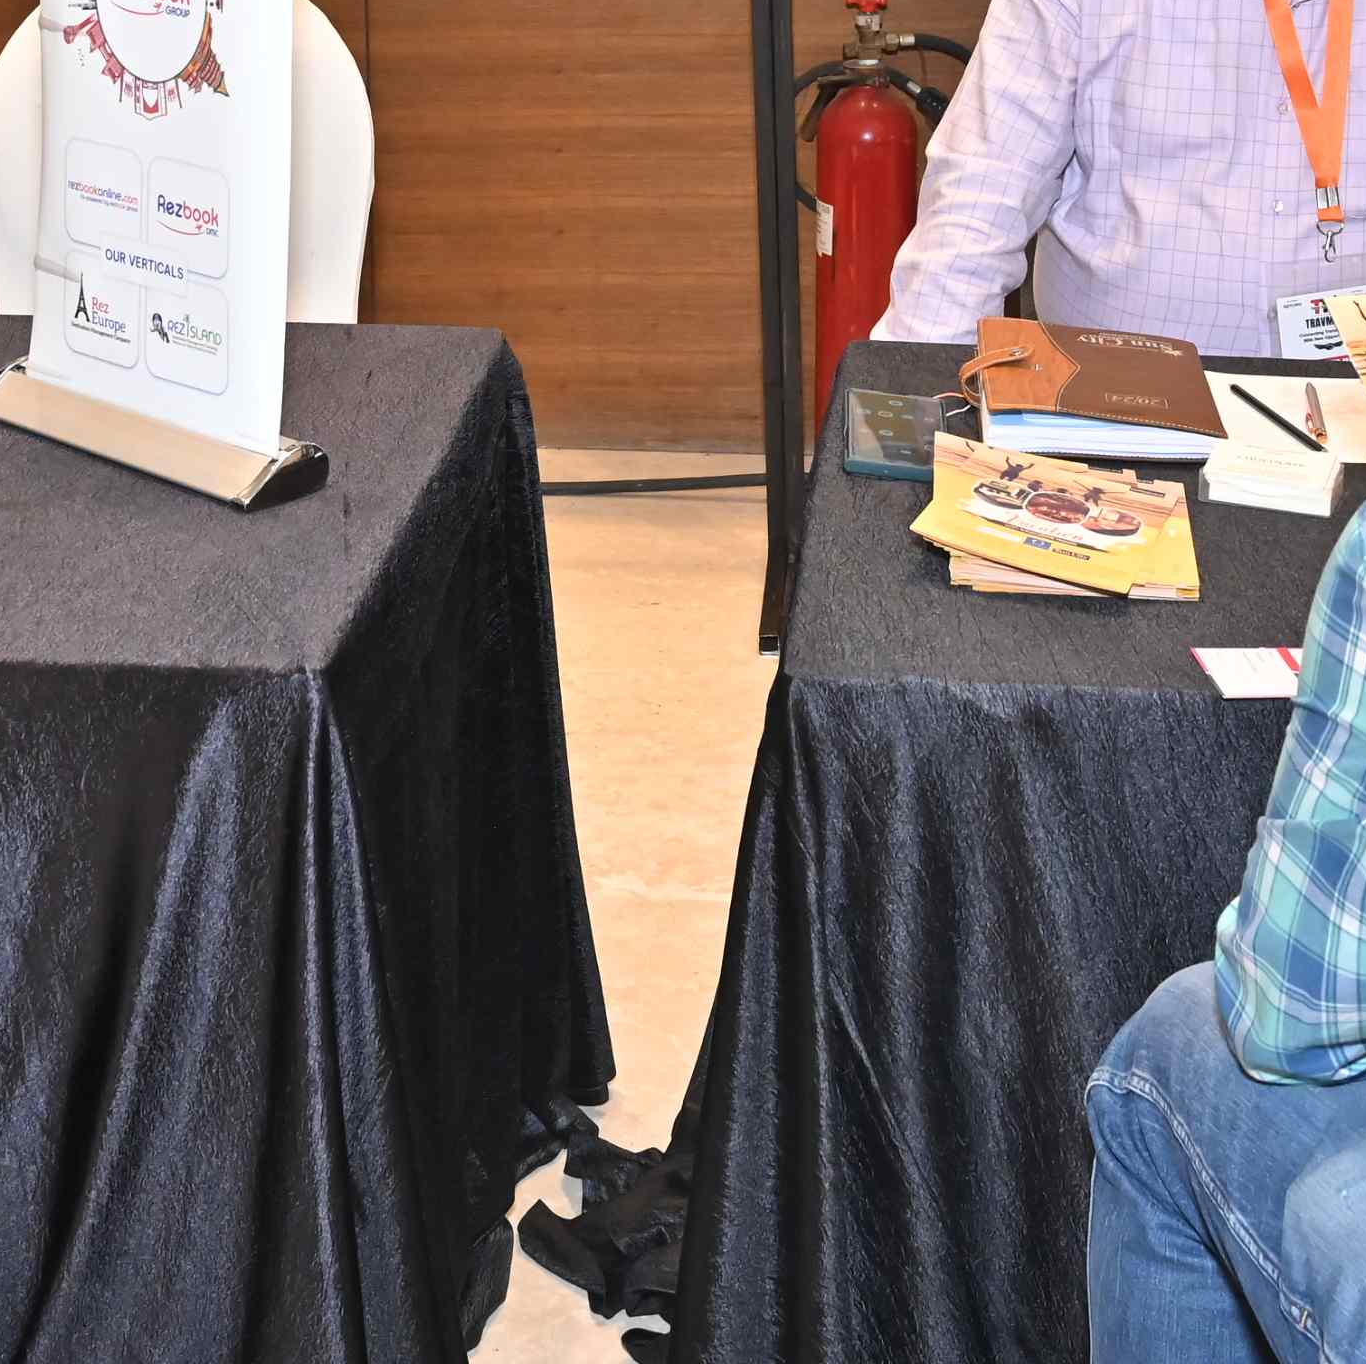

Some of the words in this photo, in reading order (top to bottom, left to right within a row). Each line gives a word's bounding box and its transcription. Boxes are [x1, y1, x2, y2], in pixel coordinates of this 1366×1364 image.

[165, 5, 190, 18] GROUP
[157, 194, 219, 226] Rezbook
[105, 249, 126, 264] OUR
[129, 254, 184, 279] VERTICALS
[92, 297, 109, 313] Rez
[92, 311, 126, 333] Europe
